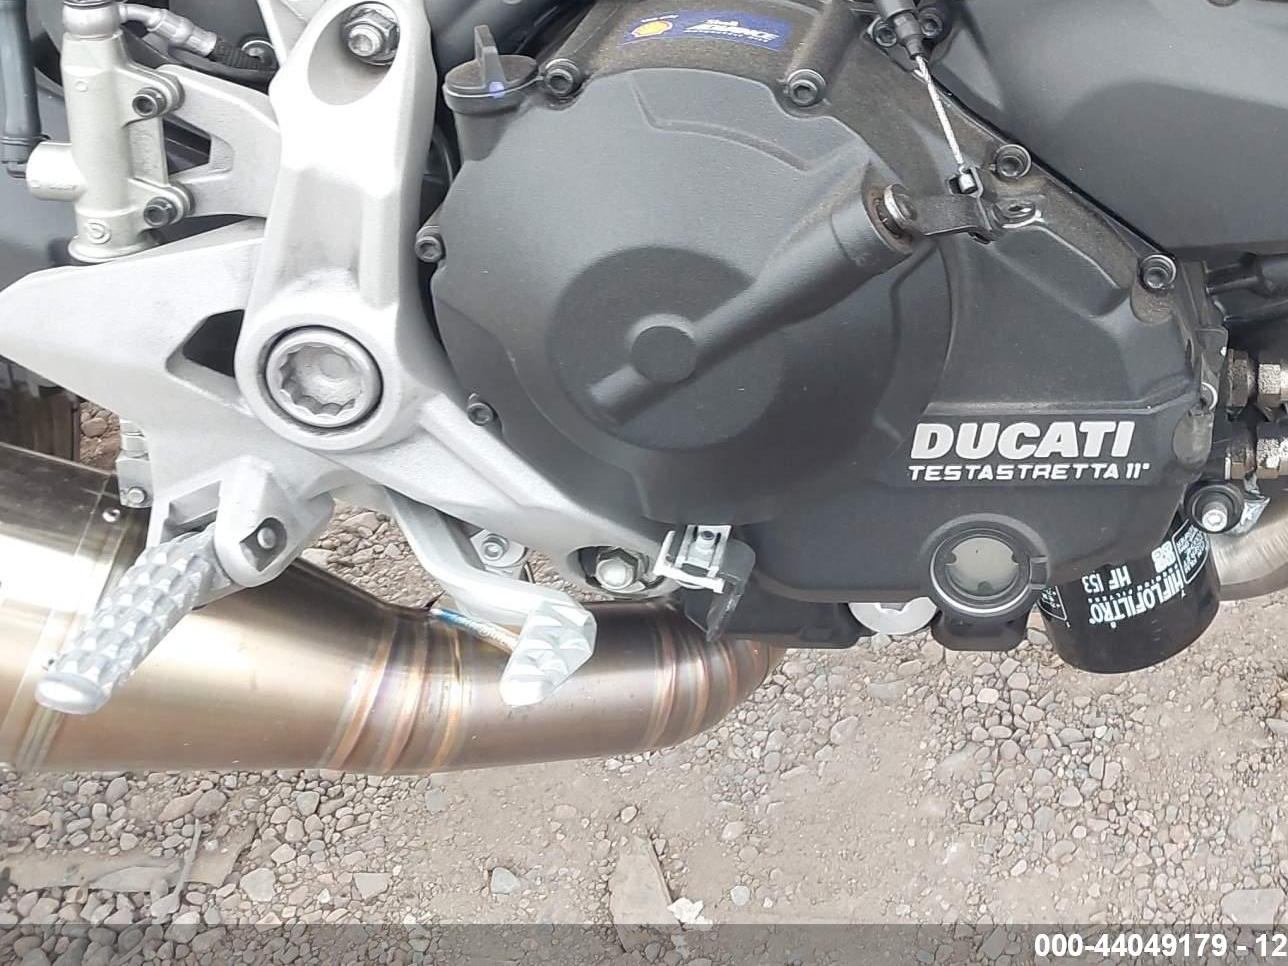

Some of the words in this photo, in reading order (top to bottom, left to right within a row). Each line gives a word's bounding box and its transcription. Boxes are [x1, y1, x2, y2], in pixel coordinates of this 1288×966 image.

[910, 420, 1136, 460] DUCATI
[908, 462, 1120, 481] TESTASTRETTA
[1108, 565, 1132, 591] HF
